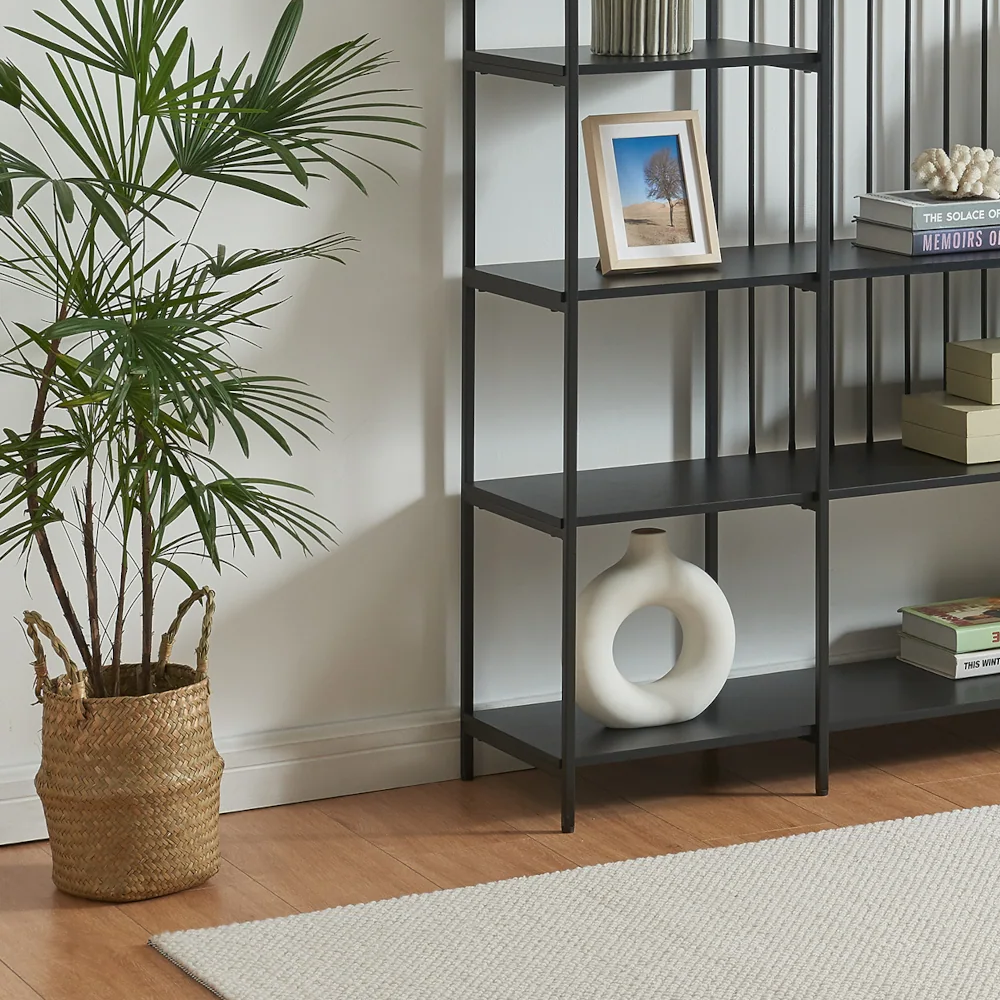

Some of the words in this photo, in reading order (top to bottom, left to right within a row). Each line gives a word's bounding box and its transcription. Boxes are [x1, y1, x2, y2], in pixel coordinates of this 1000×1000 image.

[923, 213, 943, 223] THE
[946, 210, 985, 222] SOLACE
[922, 229, 983, 252] MEMOIRS
[963, 660, 980, 671] THIS
